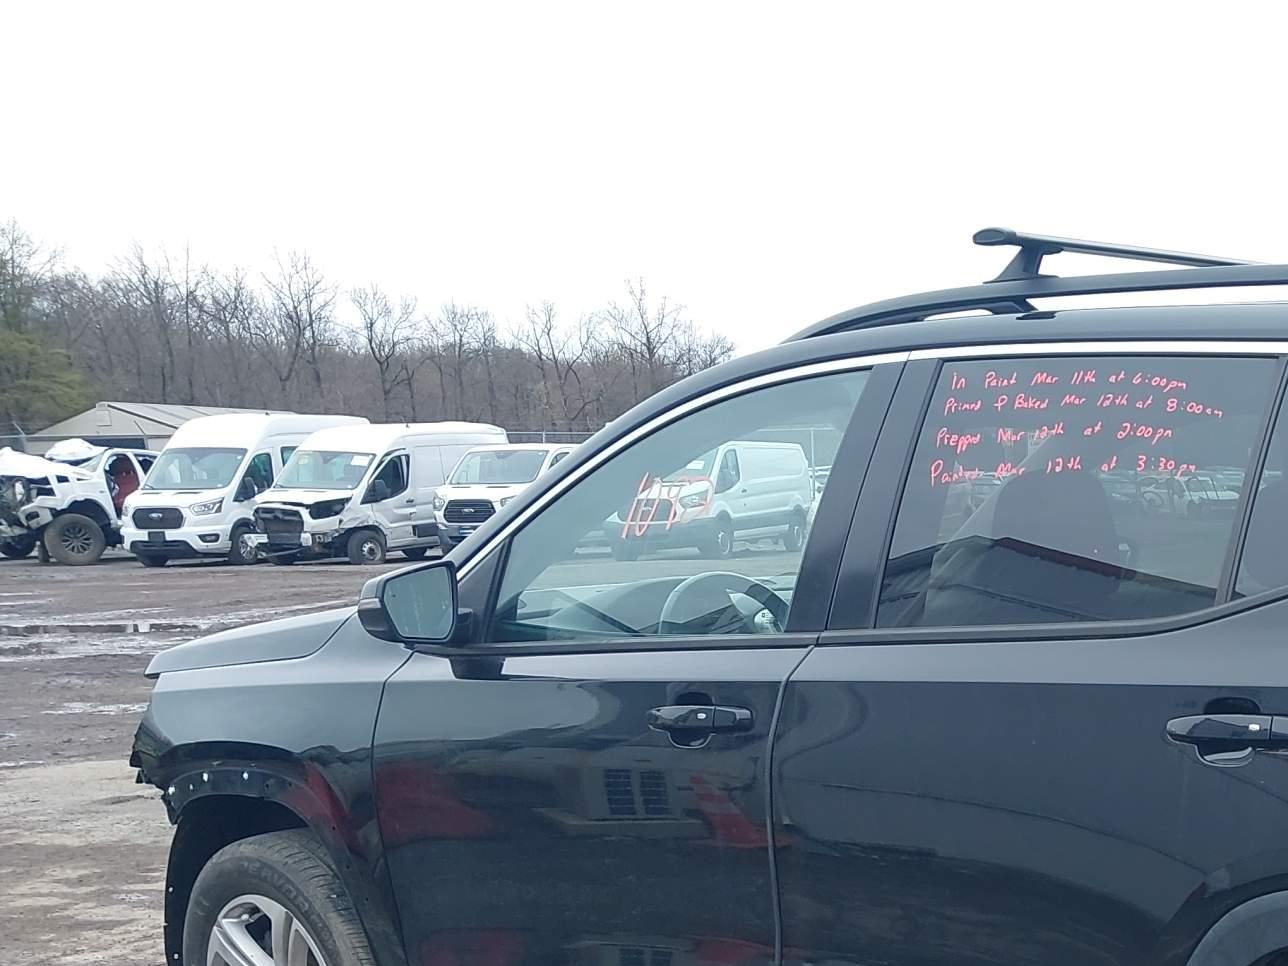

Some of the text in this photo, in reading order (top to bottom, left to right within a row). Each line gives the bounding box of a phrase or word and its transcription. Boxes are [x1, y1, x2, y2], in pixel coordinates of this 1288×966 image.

[951, 372, 966, 390] In
[1030, 372, 1058, 386] Mar
[1070, 370, 1096, 385] 11th
[1108, 371, 1125, 383] at
[1014, 393, 1049, 410] Baked
[1061, 394, 1086, 406] Mar
[1097, 393, 1128, 407] 12th
[1136, 395, 1153, 408] at
[1083, 421, 1102, 436] at
[1046, 456, 1081, 474] 12th
[1100, 455, 1118, 472] at
